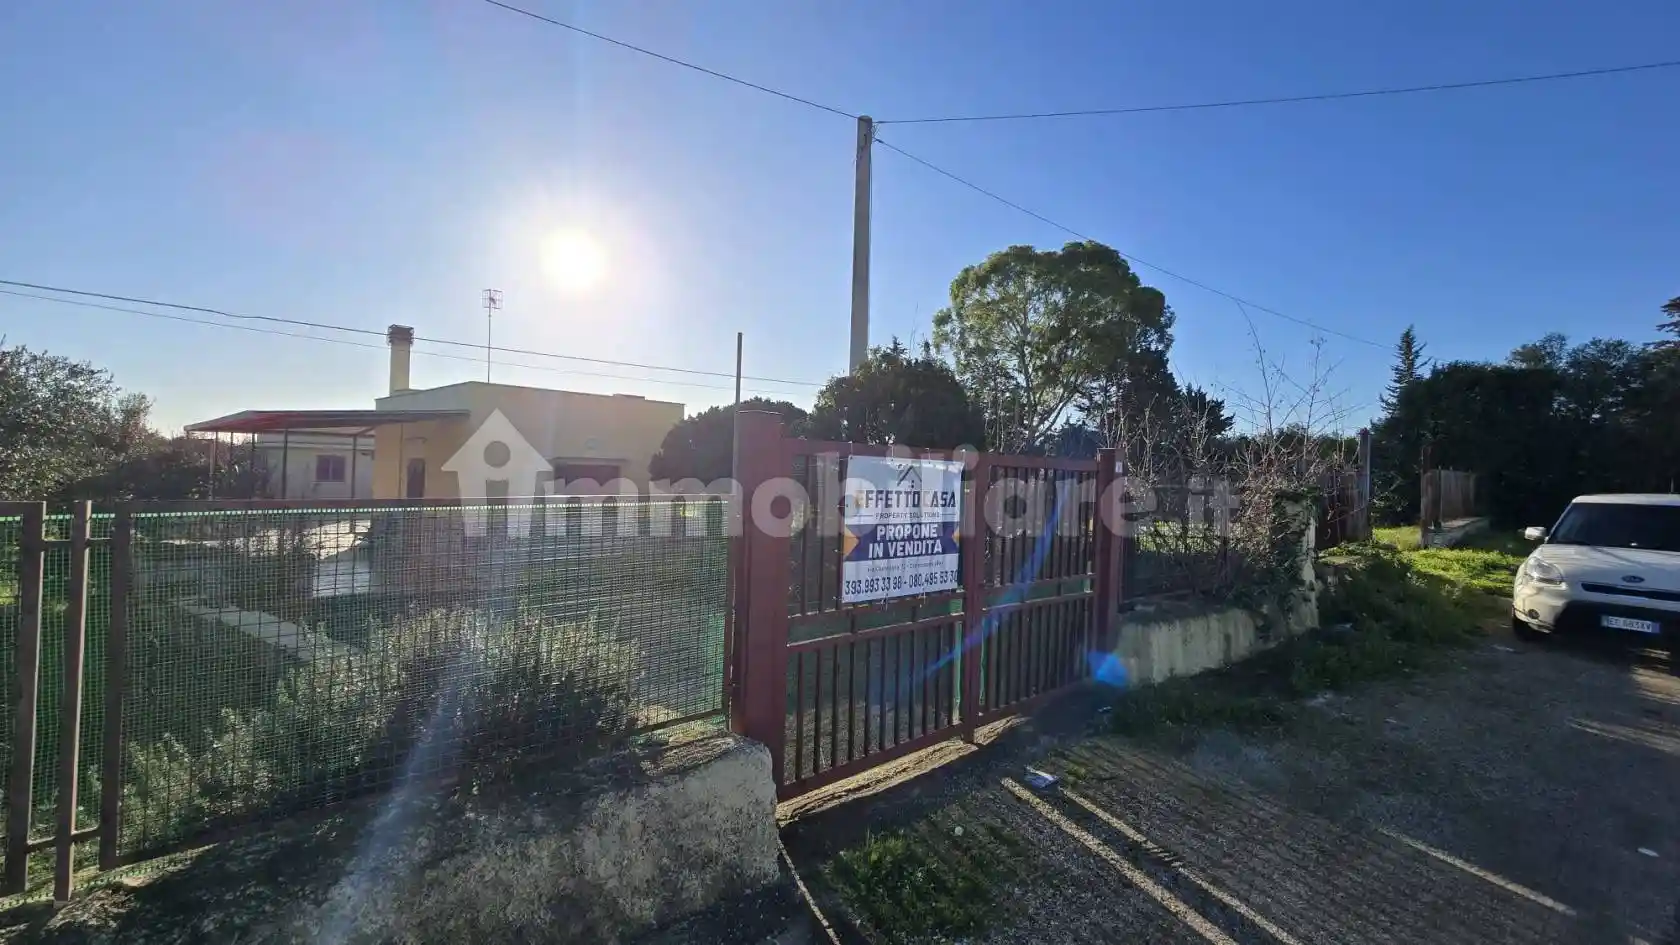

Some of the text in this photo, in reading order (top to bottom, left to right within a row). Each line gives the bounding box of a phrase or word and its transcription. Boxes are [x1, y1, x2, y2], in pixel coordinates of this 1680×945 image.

[876, 524, 938, 541] PROPONE
[868, 539, 943, 559] IN VENDITA
